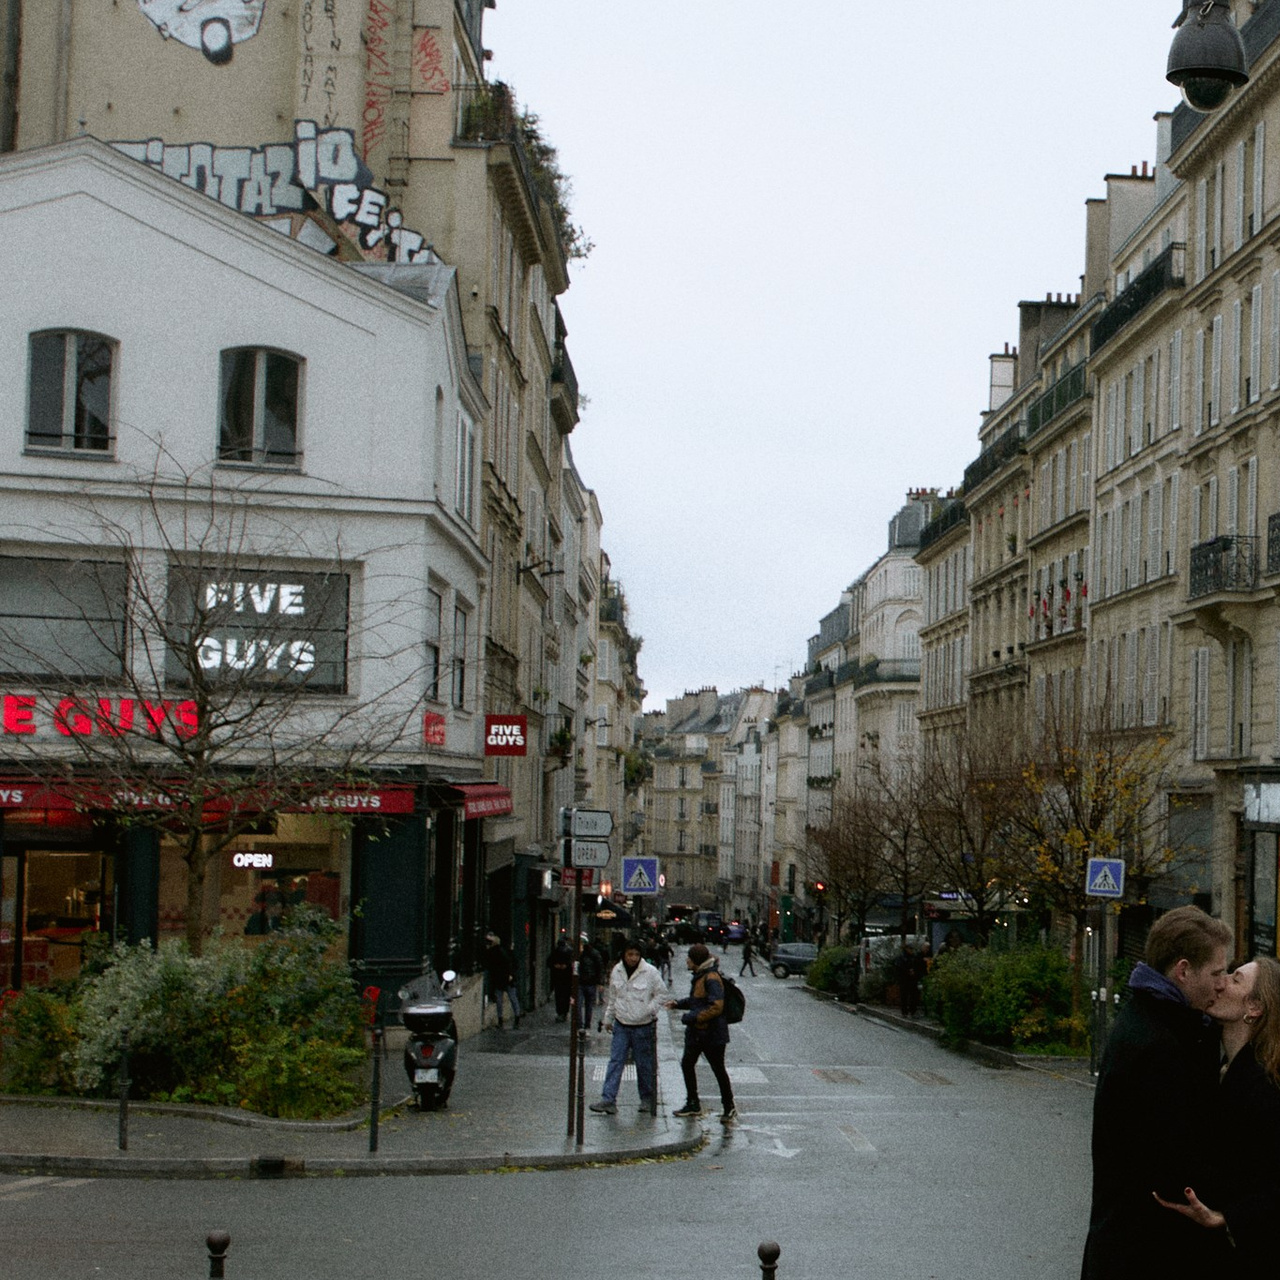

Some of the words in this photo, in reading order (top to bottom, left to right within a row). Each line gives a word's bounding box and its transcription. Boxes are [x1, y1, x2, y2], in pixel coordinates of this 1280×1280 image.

[205, 582, 306, 615] FIVE
[195, 637, 317, 672] GUYS
[54, 696, 199, 739] GUYS
[490, 724, 521, 735] FIVE
[487, 735, 525, 746] GUYS
[334, 795, 381, 808] GUYS
[233, 853, 273, 868] OPEN
